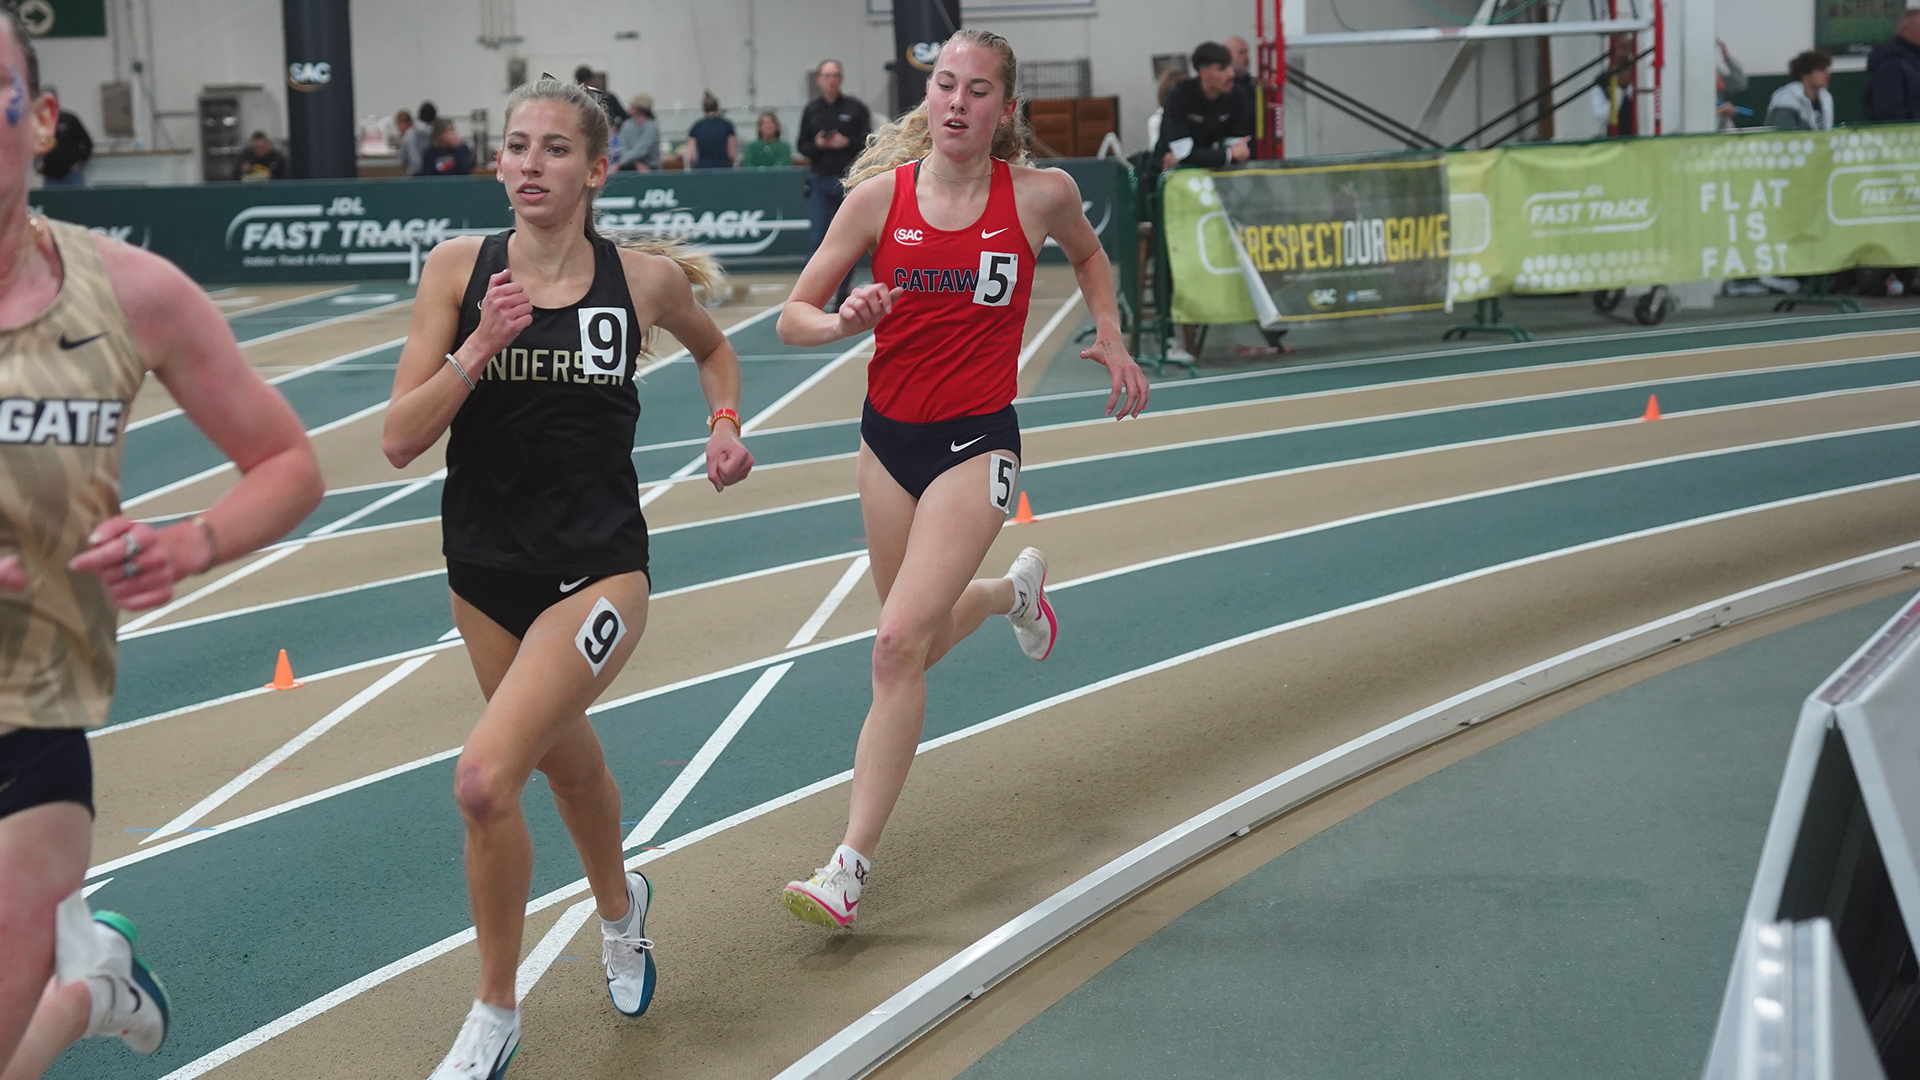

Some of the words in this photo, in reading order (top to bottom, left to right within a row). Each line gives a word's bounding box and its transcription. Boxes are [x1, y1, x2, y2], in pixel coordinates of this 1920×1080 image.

[912, 42, 941, 63] SA
[289, 62, 332, 84] SAC
[326, 196, 366, 216] JDL
[638, 188, 679, 208] JDL
[1530, 203, 1584, 225] FAST
[1588, 197, 1650, 221] TRACK
[1701, 178, 1789, 213] FLAT
[241, 221, 331, 250] FAST
[338, 217, 451, 248] TRACK
[650, 210, 765, 239] TRACK
[897, 228, 924, 241] SAC
[1728, 211, 1768, 242] IS
[1702, 242, 1788, 277] FAST
[982, 255, 1011, 304] 5
[588, 312, 622, 371] 9
[0, 397, 123, 446] GATE
[996, 458, 1013, 508] 5
[584, 610, 619, 665] 9
